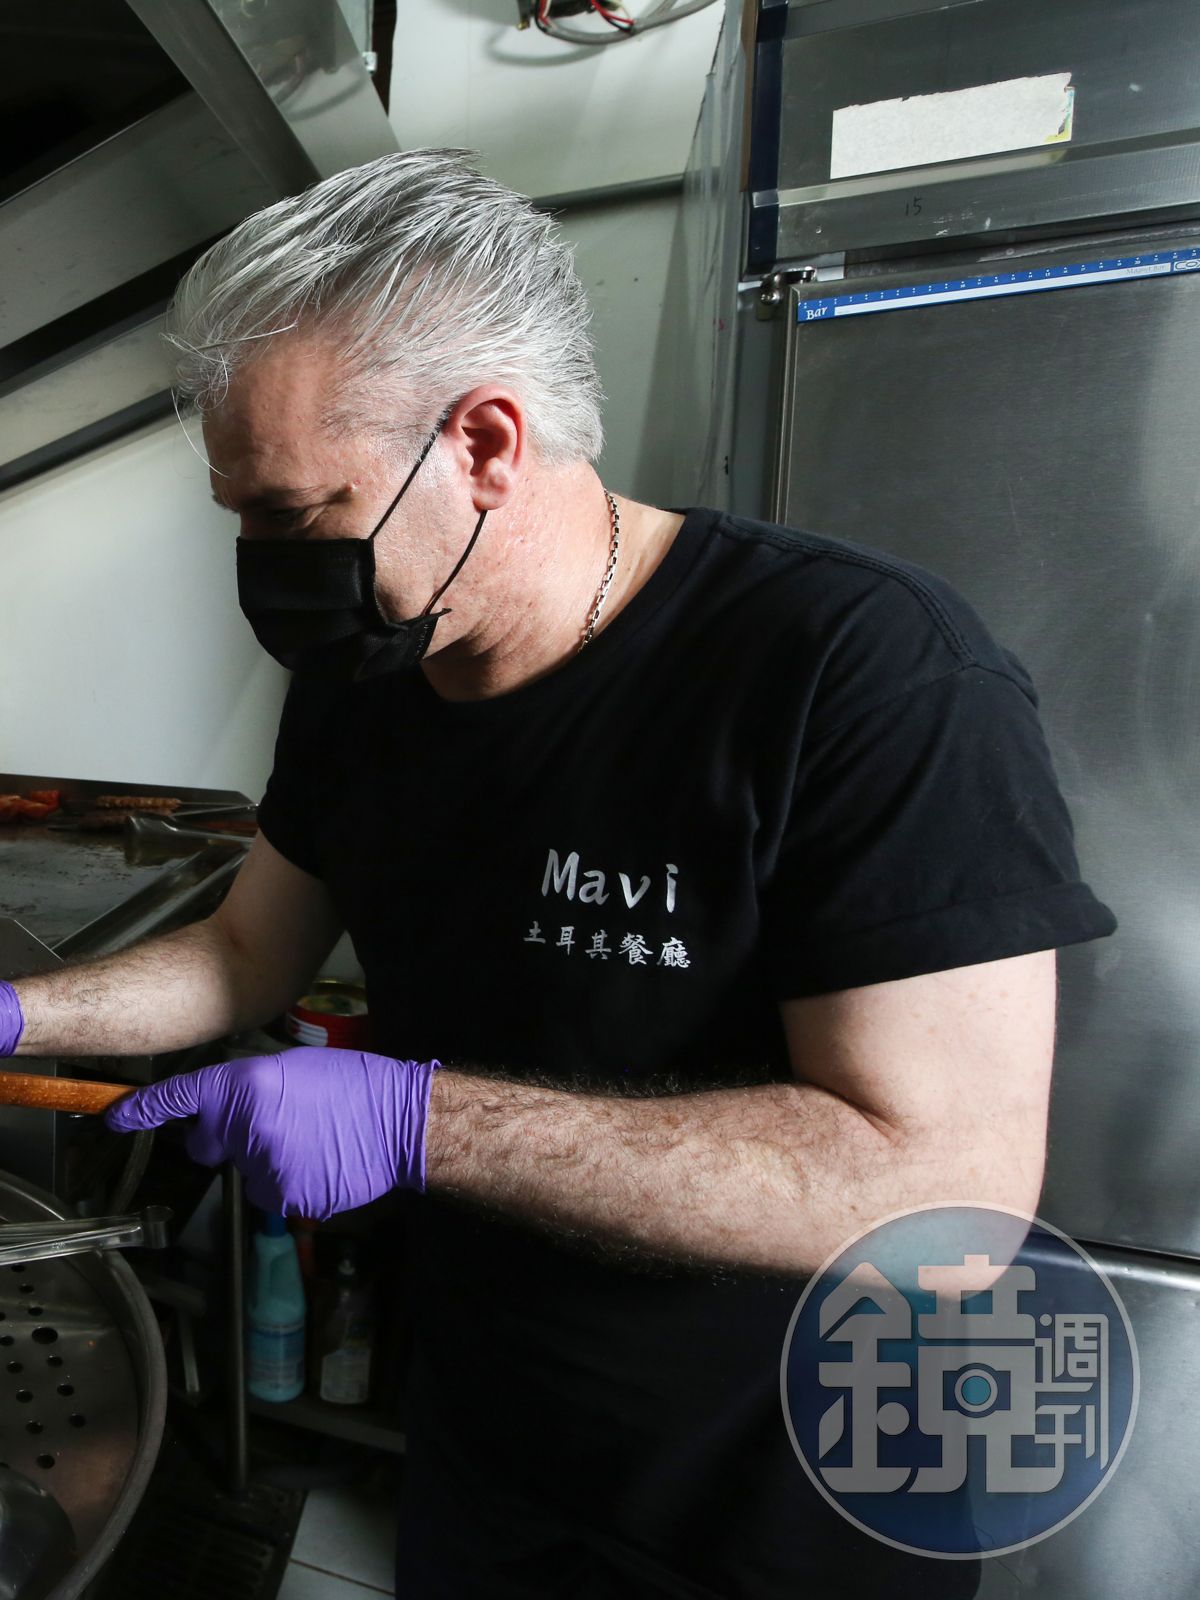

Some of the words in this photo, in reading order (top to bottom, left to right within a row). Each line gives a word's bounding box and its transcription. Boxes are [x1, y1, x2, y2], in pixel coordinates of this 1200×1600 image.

[905, 196, 922, 216] 15
[806, 307, 828, 320] Bar
[541, 849, 679, 913] Mavi
[523, 921, 691, 969] 土耳其餐廳
